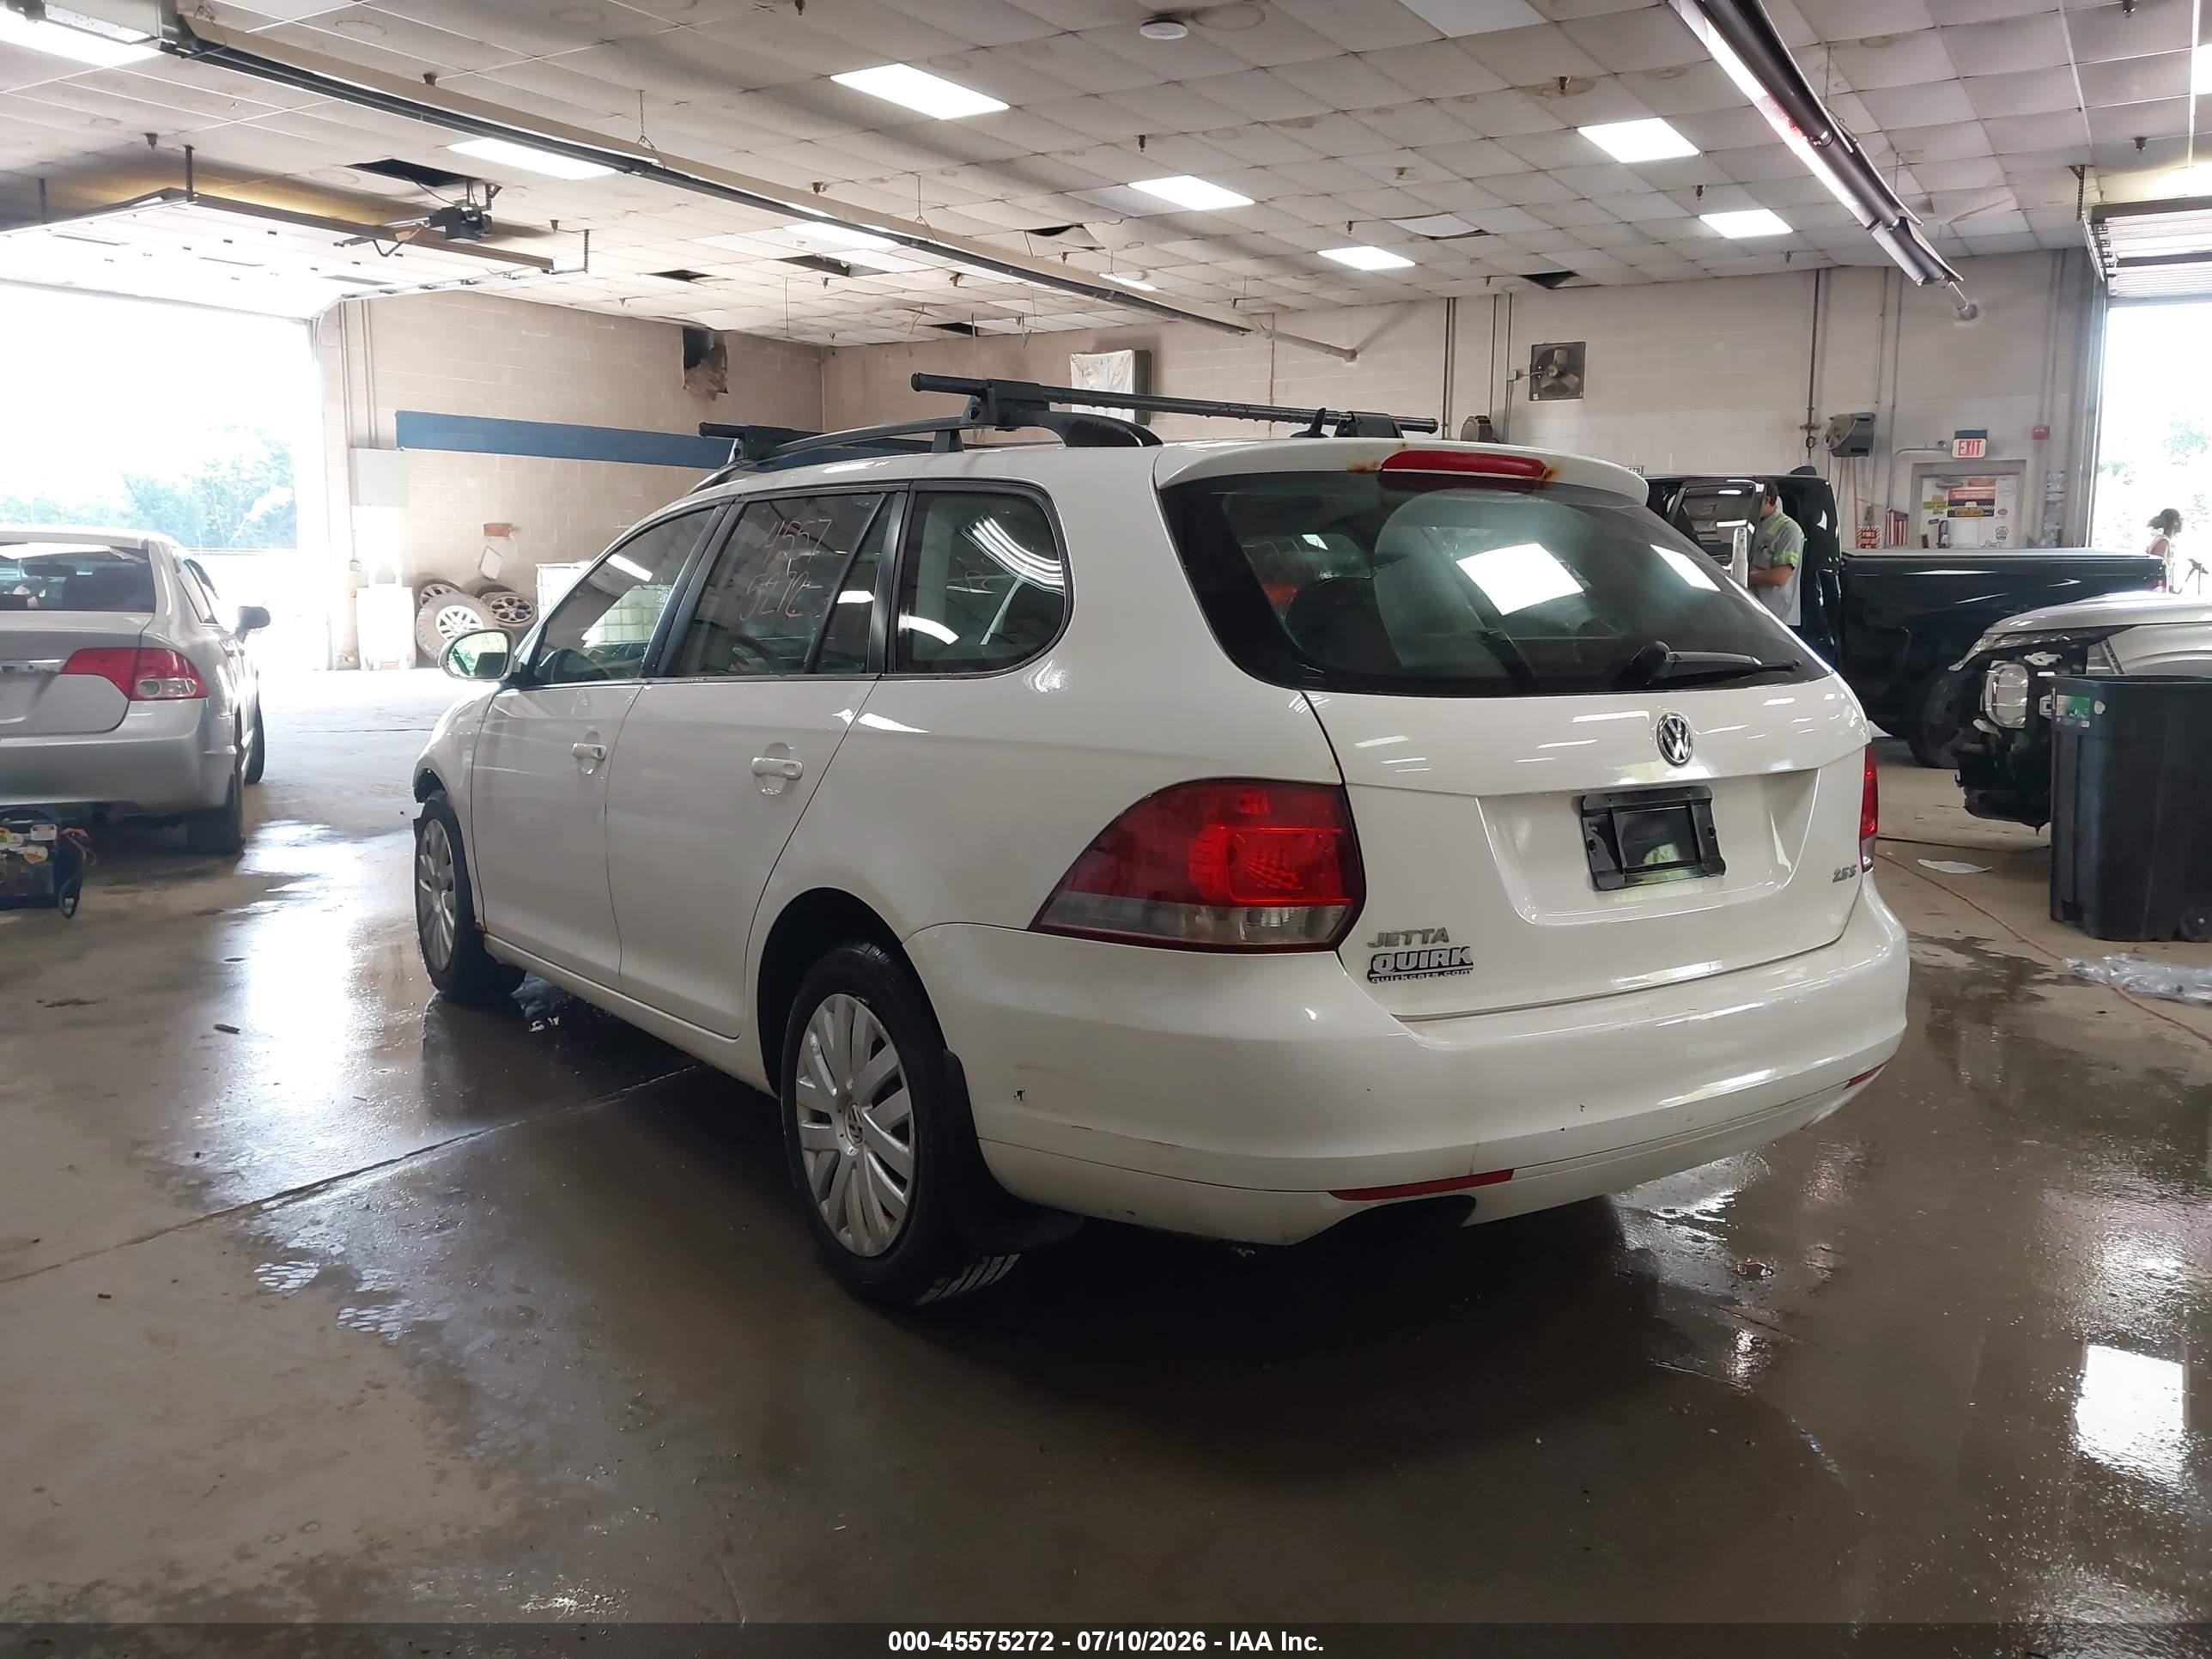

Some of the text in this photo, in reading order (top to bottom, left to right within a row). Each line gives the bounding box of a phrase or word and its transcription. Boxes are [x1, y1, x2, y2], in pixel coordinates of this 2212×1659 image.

[1958, 440, 1982, 457] EXIT
[1367, 927, 1449, 948] JETTA
[1371, 945, 1473, 975] QUIRK
